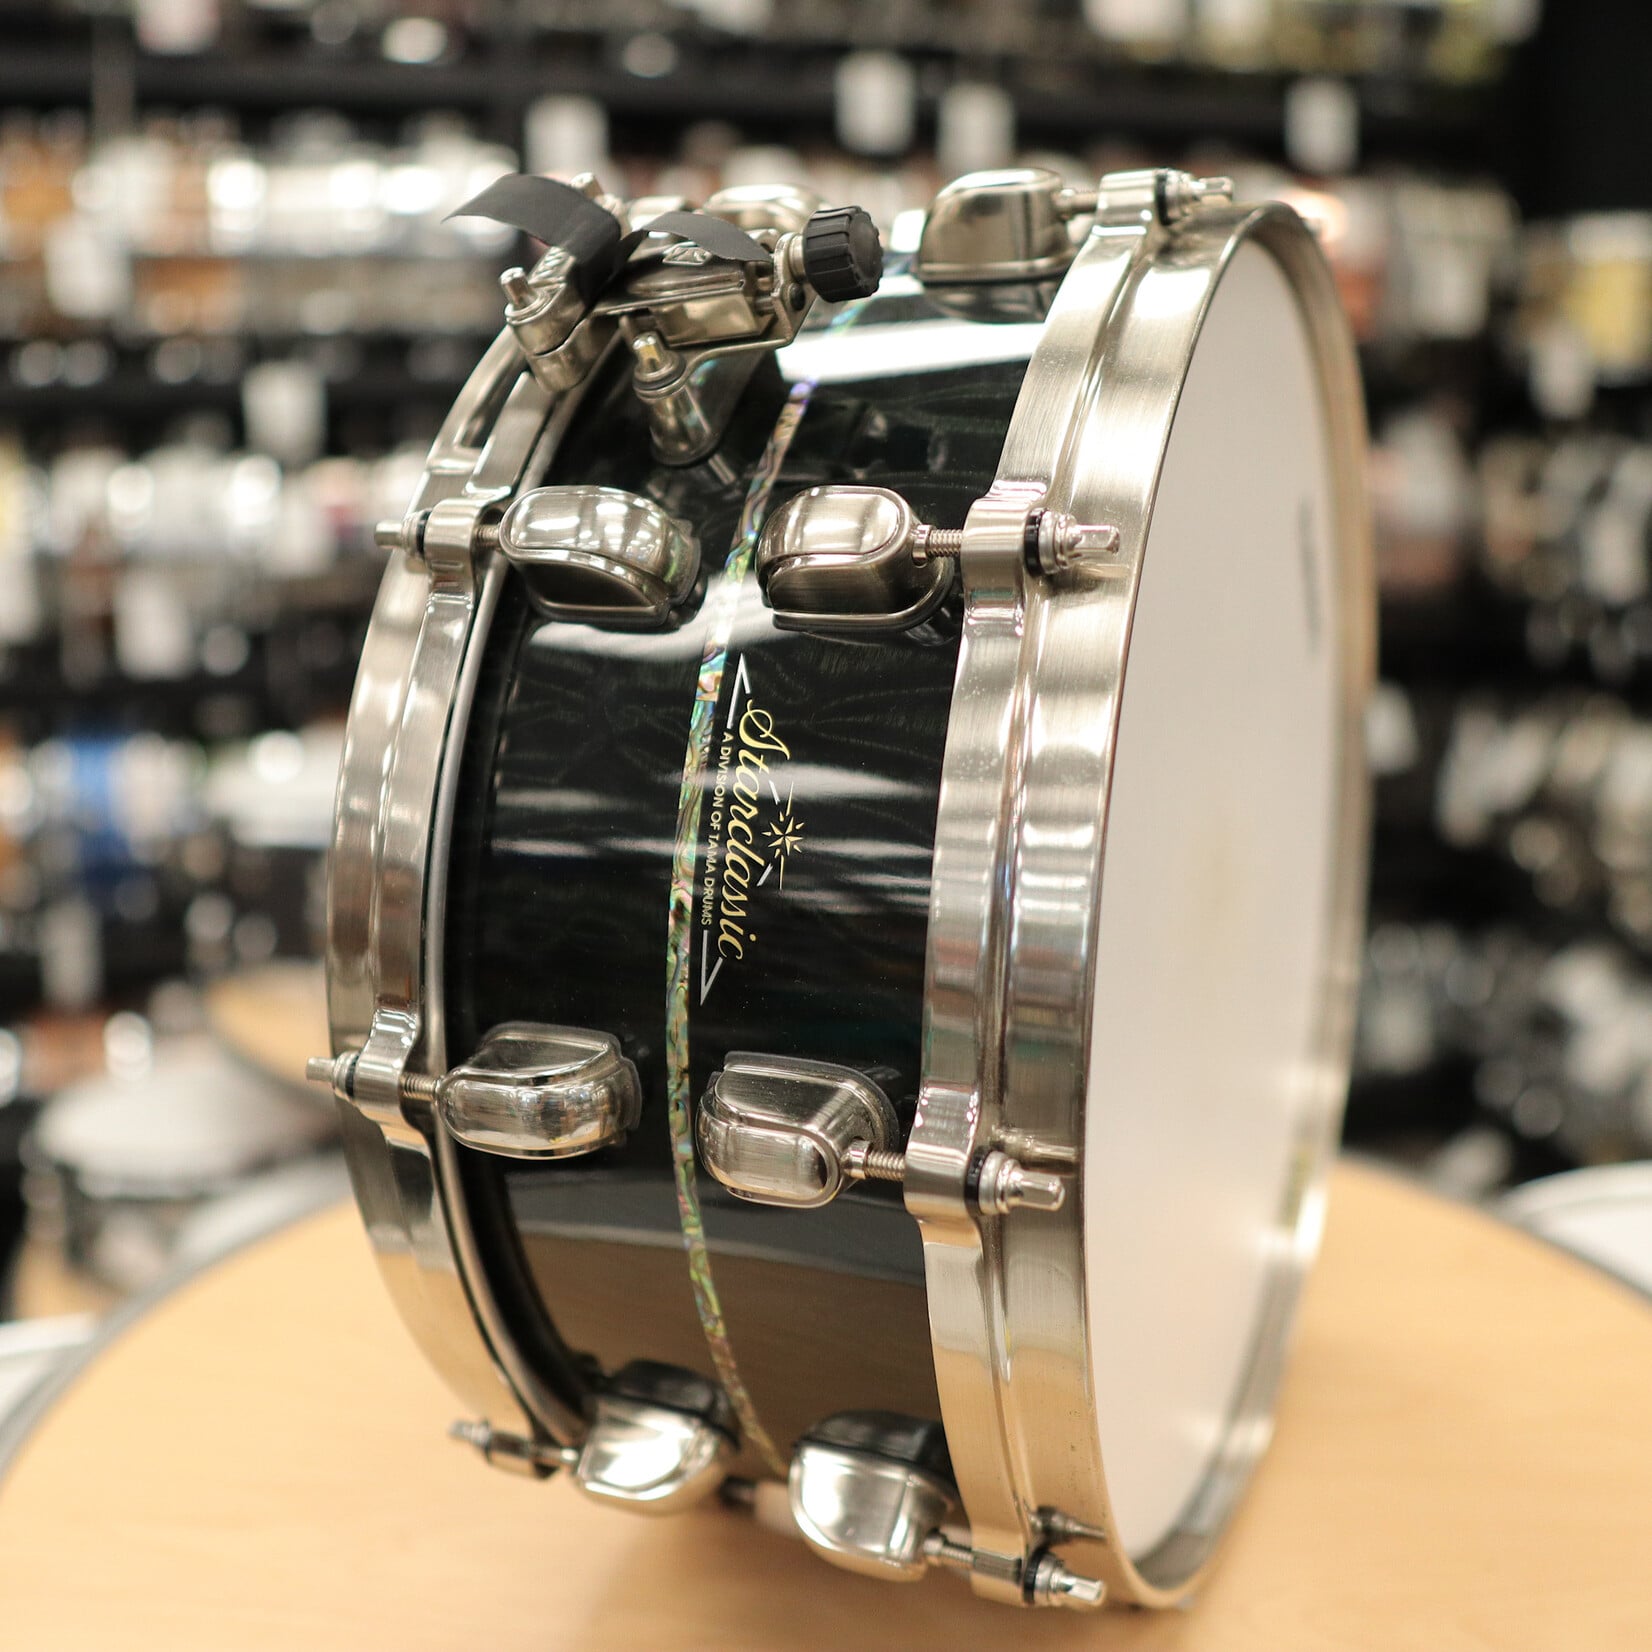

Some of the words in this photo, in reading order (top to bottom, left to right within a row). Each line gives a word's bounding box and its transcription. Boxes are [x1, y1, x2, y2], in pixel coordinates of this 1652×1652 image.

[721, 731, 735, 743] A
[712, 746, 732, 808] DIVISION
[709, 811, 723, 831] OF
[717, 699, 791, 961] Starclassic
[704, 833, 721, 874] TAMA
[701, 877, 716, 926] DRUMS
